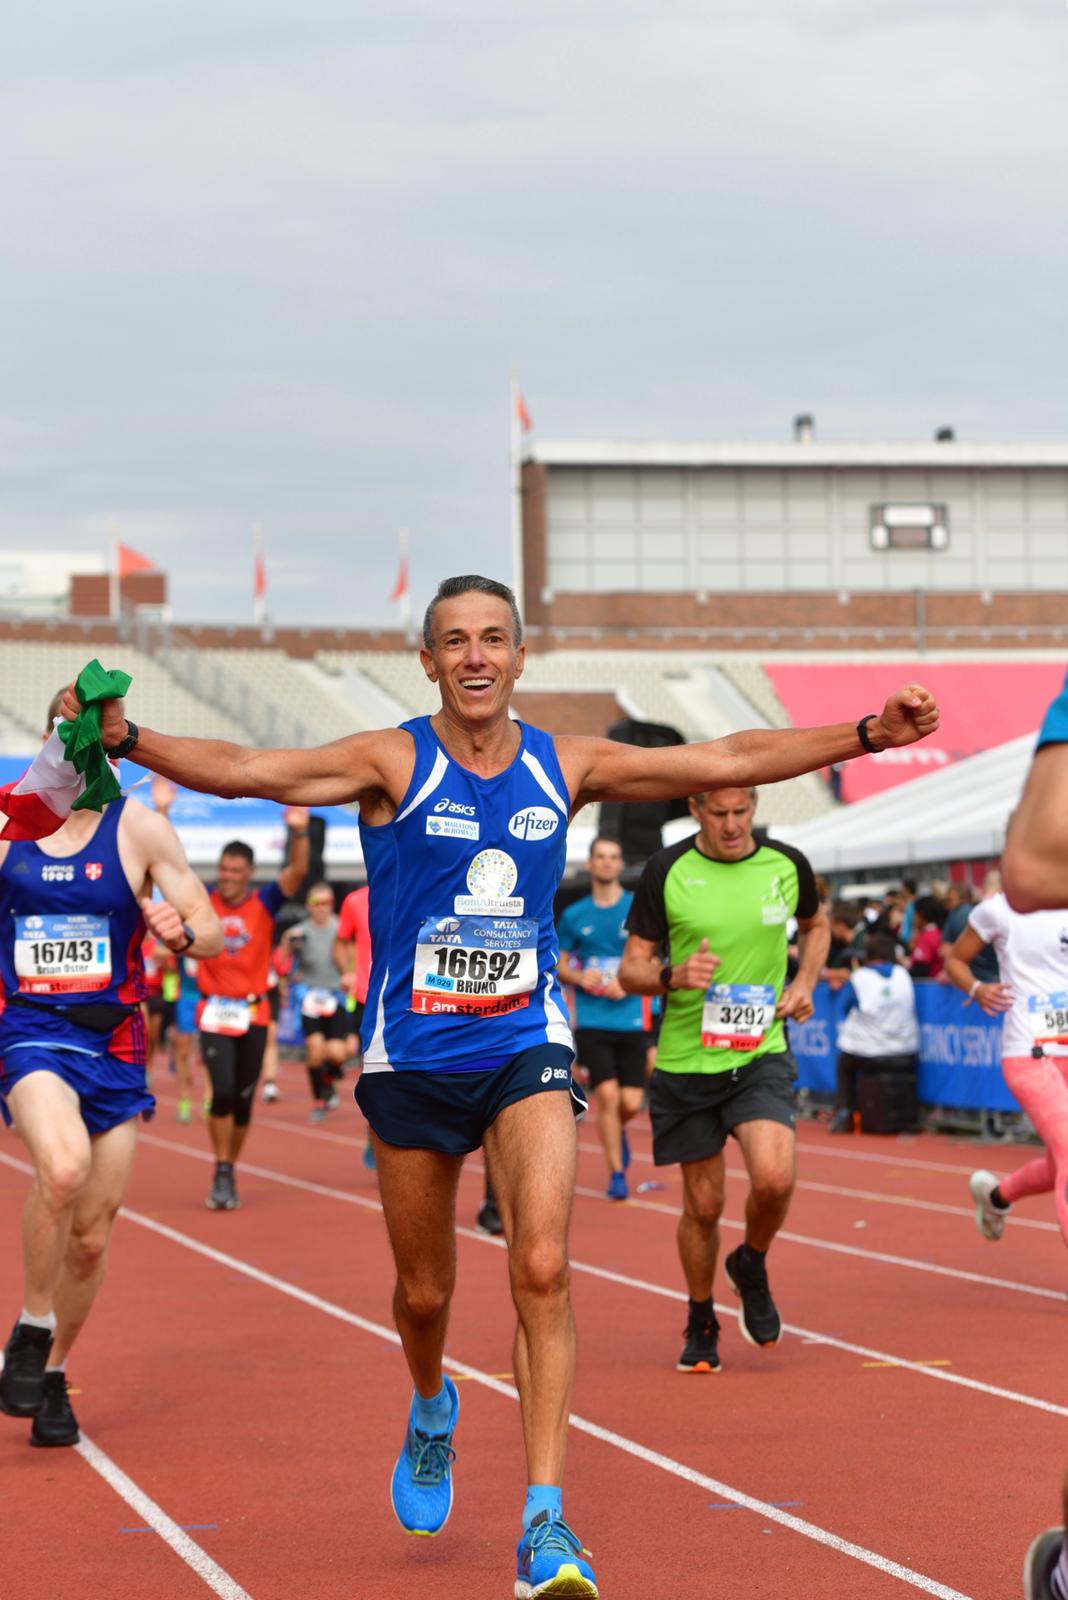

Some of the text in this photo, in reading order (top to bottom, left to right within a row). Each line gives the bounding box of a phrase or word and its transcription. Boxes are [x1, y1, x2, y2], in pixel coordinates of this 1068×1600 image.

[513, 811, 558, 840] Pfizer
[492, 920, 518, 929] TATA
[429, 934, 462, 944] TATA
[473, 929, 532, 939] CONSULTANCY
[484, 938, 521, 948] SERVICES
[30, 940, 93, 965] 16743
[434, 946, 521, 981] 16692
[428, 976, 451, 988] M 929
[456, 980, 497, 994] BRUNO
[421, 996, 521, 1016] I amsterdam
[720, 1005, 766, 1026] 3292
